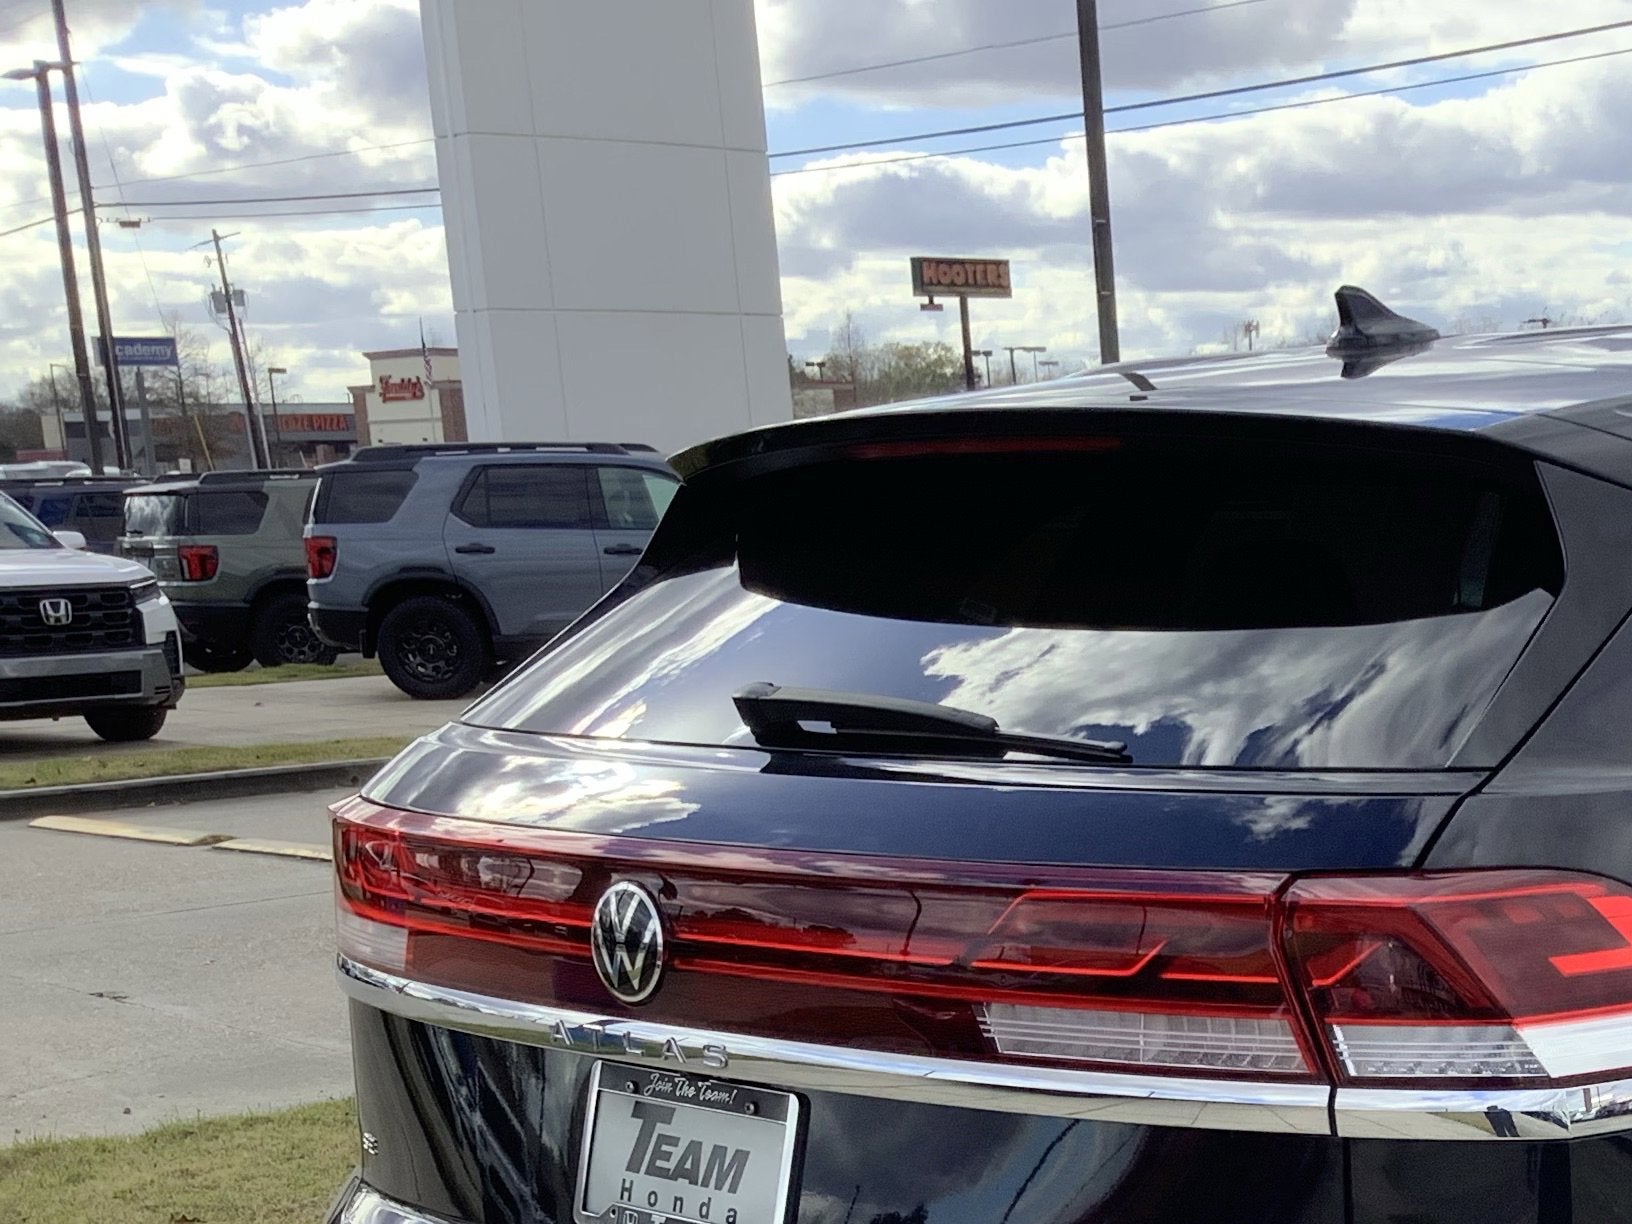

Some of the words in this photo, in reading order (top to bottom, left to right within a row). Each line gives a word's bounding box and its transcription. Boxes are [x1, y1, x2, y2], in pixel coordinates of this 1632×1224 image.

[921, 261, 1009, 288] HOOTERS
[114, 343, 173, 360] cademy
[312, 414, 347, 431] PIZZA
[552, 1019, 729, 1068] ATLAS
[643, 1073, 673, 1096] Join
[674, 1078, 697, 1098] The
[698, 1081, 738, 1104] Team!
